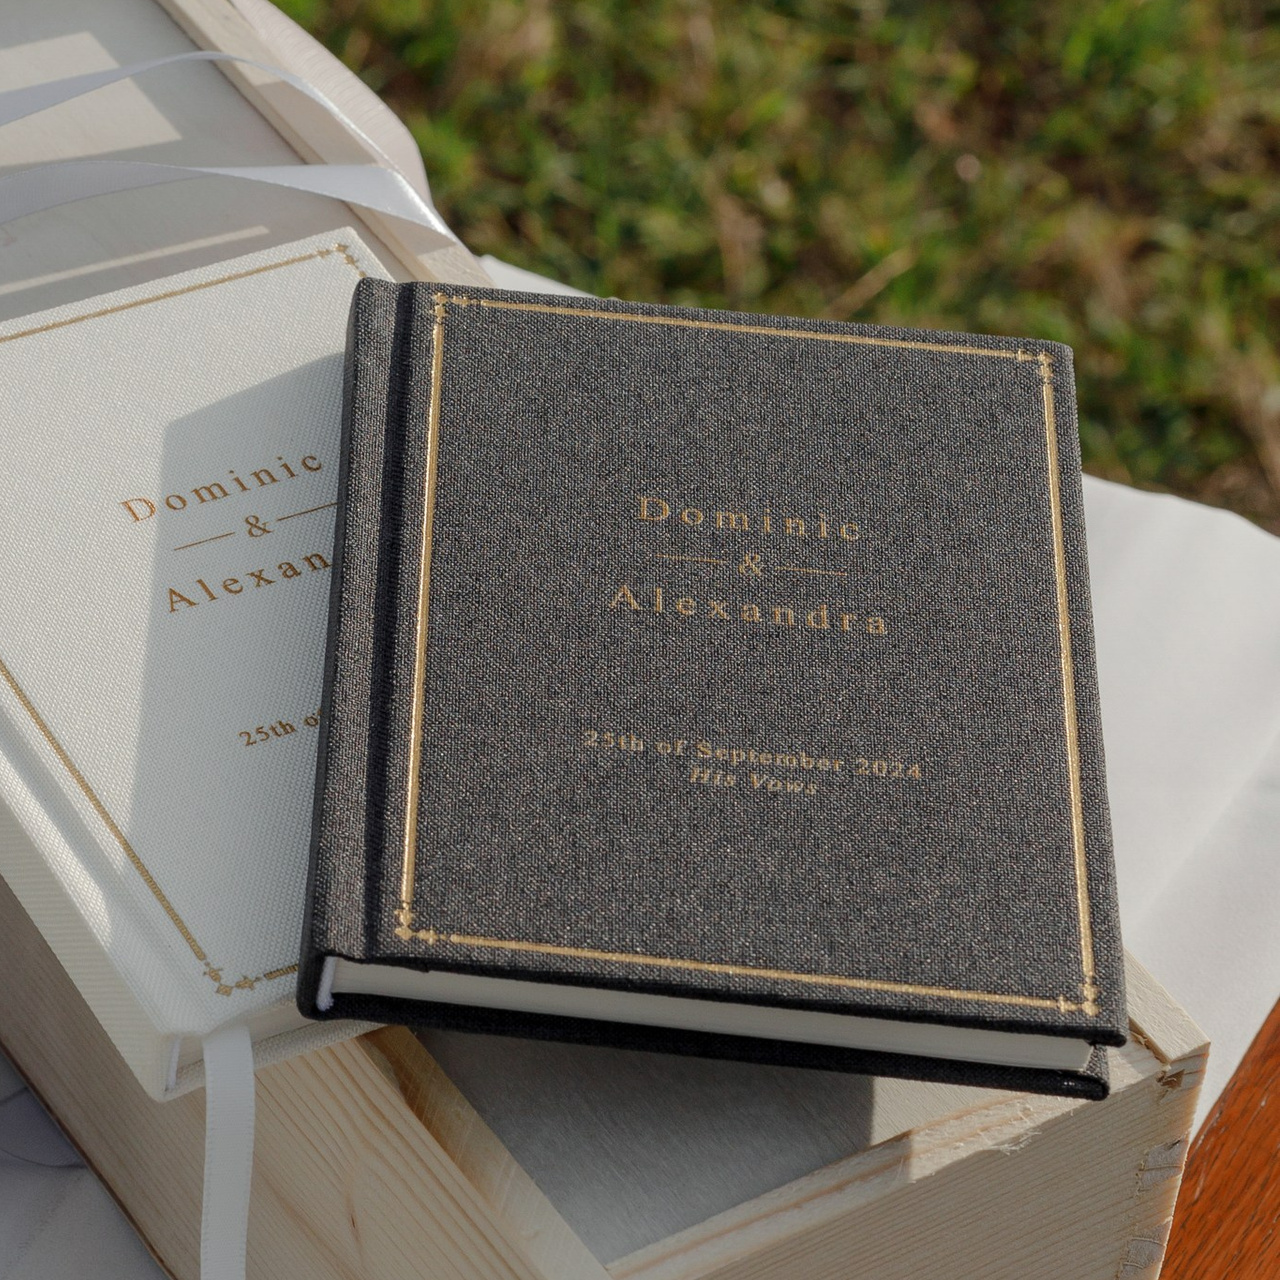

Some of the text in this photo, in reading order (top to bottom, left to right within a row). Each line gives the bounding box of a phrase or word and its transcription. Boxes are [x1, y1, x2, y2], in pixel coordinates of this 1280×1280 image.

[119, 453, 323, 524] Dominic
[243, 514, 274, 539] &
[637, 496, 861, 542] Dominic
[168, 550, 335, 614] Alexan
[737, 551, 764, 578] &
[609, 583, 889, 636] Alexandra
[238, 719, 297, 748] 25th
[582, 727, 923, 781] 25th of September 2024
[688, 765, 819, 796] His Vows
